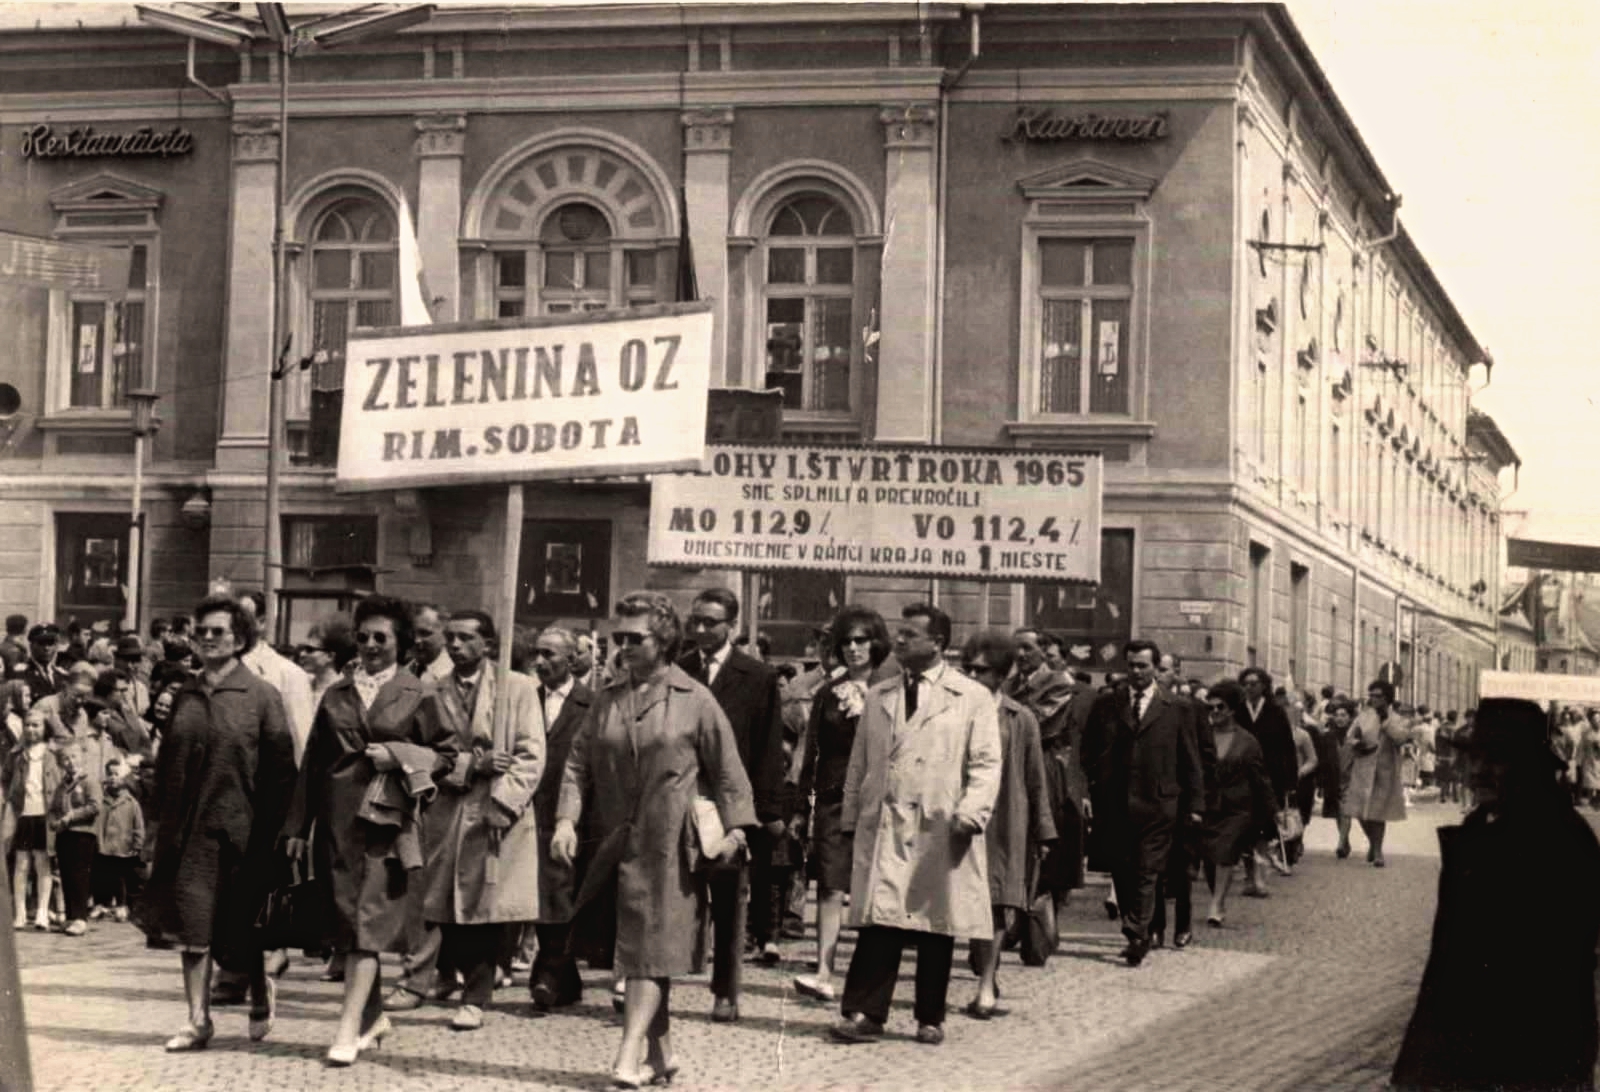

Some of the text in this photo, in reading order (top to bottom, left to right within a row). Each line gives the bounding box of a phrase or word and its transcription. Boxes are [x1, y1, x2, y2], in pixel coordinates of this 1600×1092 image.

[362, 335, 682, 412] ZELENINA OZ
[1014, 460, 1085, 487] 1965
[742, 484, 774, 501] SME
[669, 507, 717, 532] MO
[912, 513, 955, 540] VO
[798, 544, 808, 558] V
[870, 547, 932, 565] KRAJA
[942, 550, 966, 567] NA
